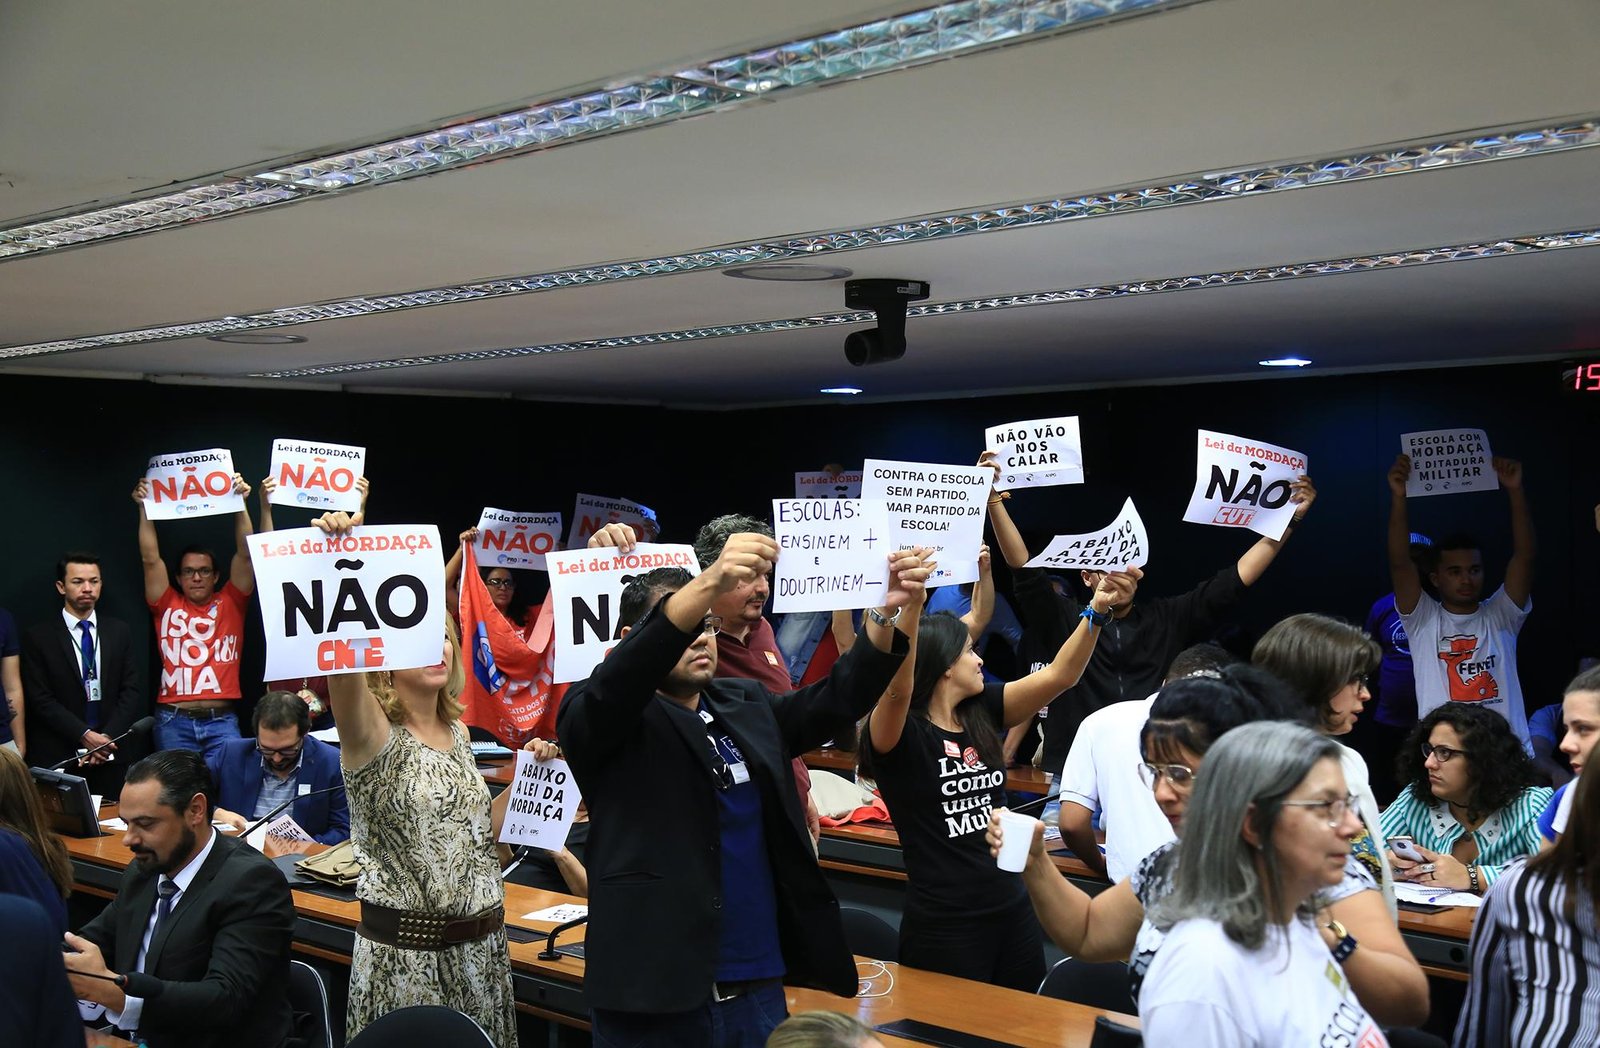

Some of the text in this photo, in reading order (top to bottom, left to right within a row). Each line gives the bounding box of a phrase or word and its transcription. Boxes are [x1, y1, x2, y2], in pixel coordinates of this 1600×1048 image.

[996, 424, 1066, 444] NÃO VÃO
[1410, 433, 1481, 446] ESCOLA COM
[278, 444, 360, 460] Lei da MORDAÇA
[1016, 441, 1048, 454] NOS
[1204, 438, 1305, 470] Lei da MORDAÇA
[1412, 443, 1484, 458] MORDAÇA
[149, 461, 159, 469] ei
[1007, 453, 1058, 467] CALAR
[1425, 456, 1485, 469] DITADURA
[279, 457, 354, 493] NÃO
[800, 476, 815, 485] Lei
[816, 476, 828, 484] da
[874, 468, 985, 486] CONTRA O ESCOLA
[1419, 467, 1481, 481] MILITAR
[151, 466, 232, 504] NÃO
[886, 486, 970, 502] SEM PARTIDO,
[1205, 461, 1293, 510] NÃO
[580, 498, 594, 507] Lei
[595, 500, 605, 508] da
[779, 500, 861, 523] ESCOLAS:
[915, 504, 965, 516] PARTIDO
[967, 506, 981, 516] DA
[483, 511, 559, 526] Lei da MORDAÇA
[900, 519, 950, 531] ESCOLA!
[482, 525, 554, 555] NÃO
[781, 535, 850, 550] ENSINEM
[1069, 520, 1133, 550] ABAIXO
[261, 535, 433, 558] Lei da MORDAÇA
[1044, 546, 1141, 566] MORDAÇA
[1079, 547, 1112, 558] LEI
[1119, 534, 1138, 553] DA
[556, 559, 586, 575] Lei
[589, 558, 610, 571] da
[814, 556, 820, 566] E
[779, 574, 864, 597] DOUTRINEM
[282, 558, 429, 638] NÃO
[161, 607, 216, 641] ISO
[161, 638, 209, 666] NO
[317, 637, 385, 672] CNTE
[1459, 655, 1496, 675] FENET
[161, 665, 222, 696] MIA
[526, 700, 540, 711] DOS
[522, 763, 566, 785] ABAIXO
[941, 770, 1004, 796] como
[516, 780, 564, 804] A LEI DA
[510, 797, 563, 822] MORDAÇA
[945, 804, 993, 839] Mul
